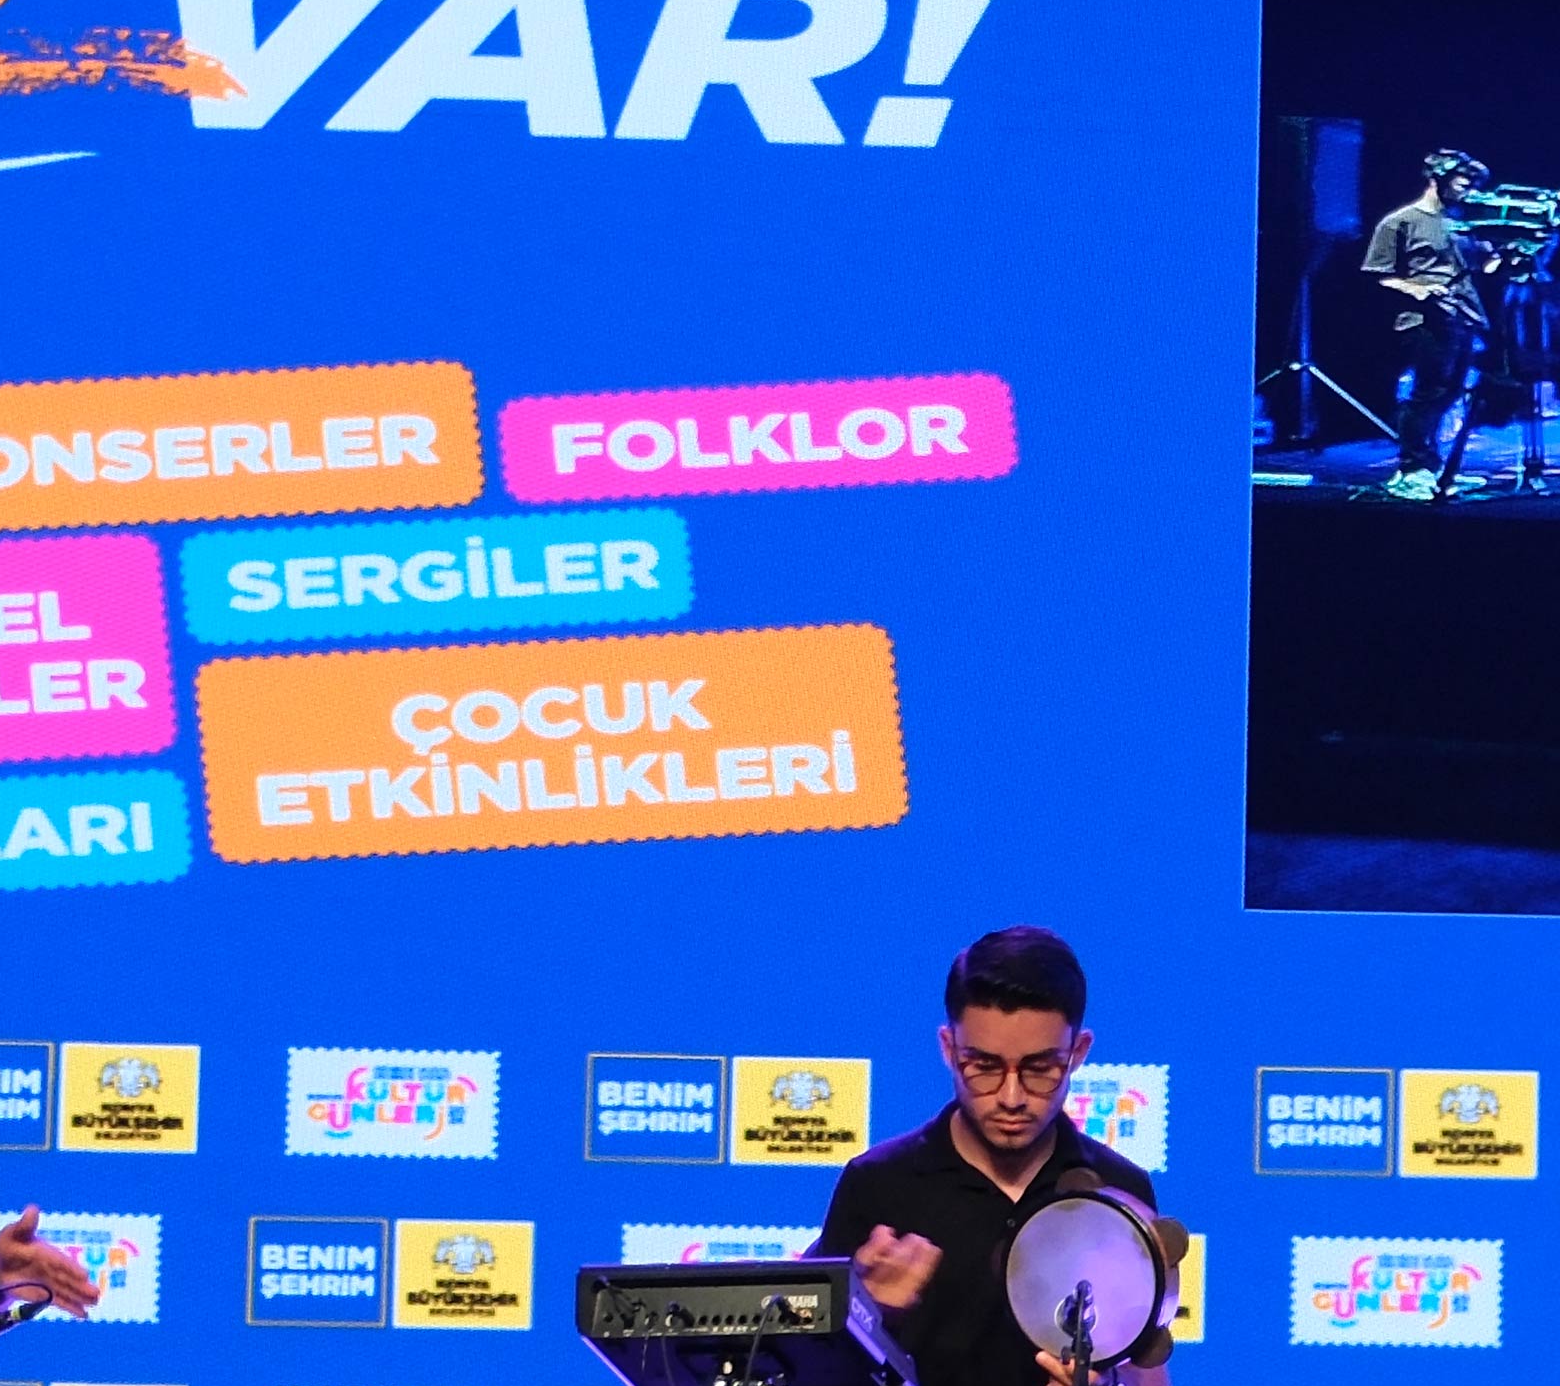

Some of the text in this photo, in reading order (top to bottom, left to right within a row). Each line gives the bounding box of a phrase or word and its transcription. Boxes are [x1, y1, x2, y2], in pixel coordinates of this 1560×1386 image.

[552, 405, 969, 473] FOLKLOR
[228, 537, 660, 612] SERGİLER
[391, 679, 711, 756] ÇOCUK
[256, 729, 857, 827] ETKİNLİKLERİ
